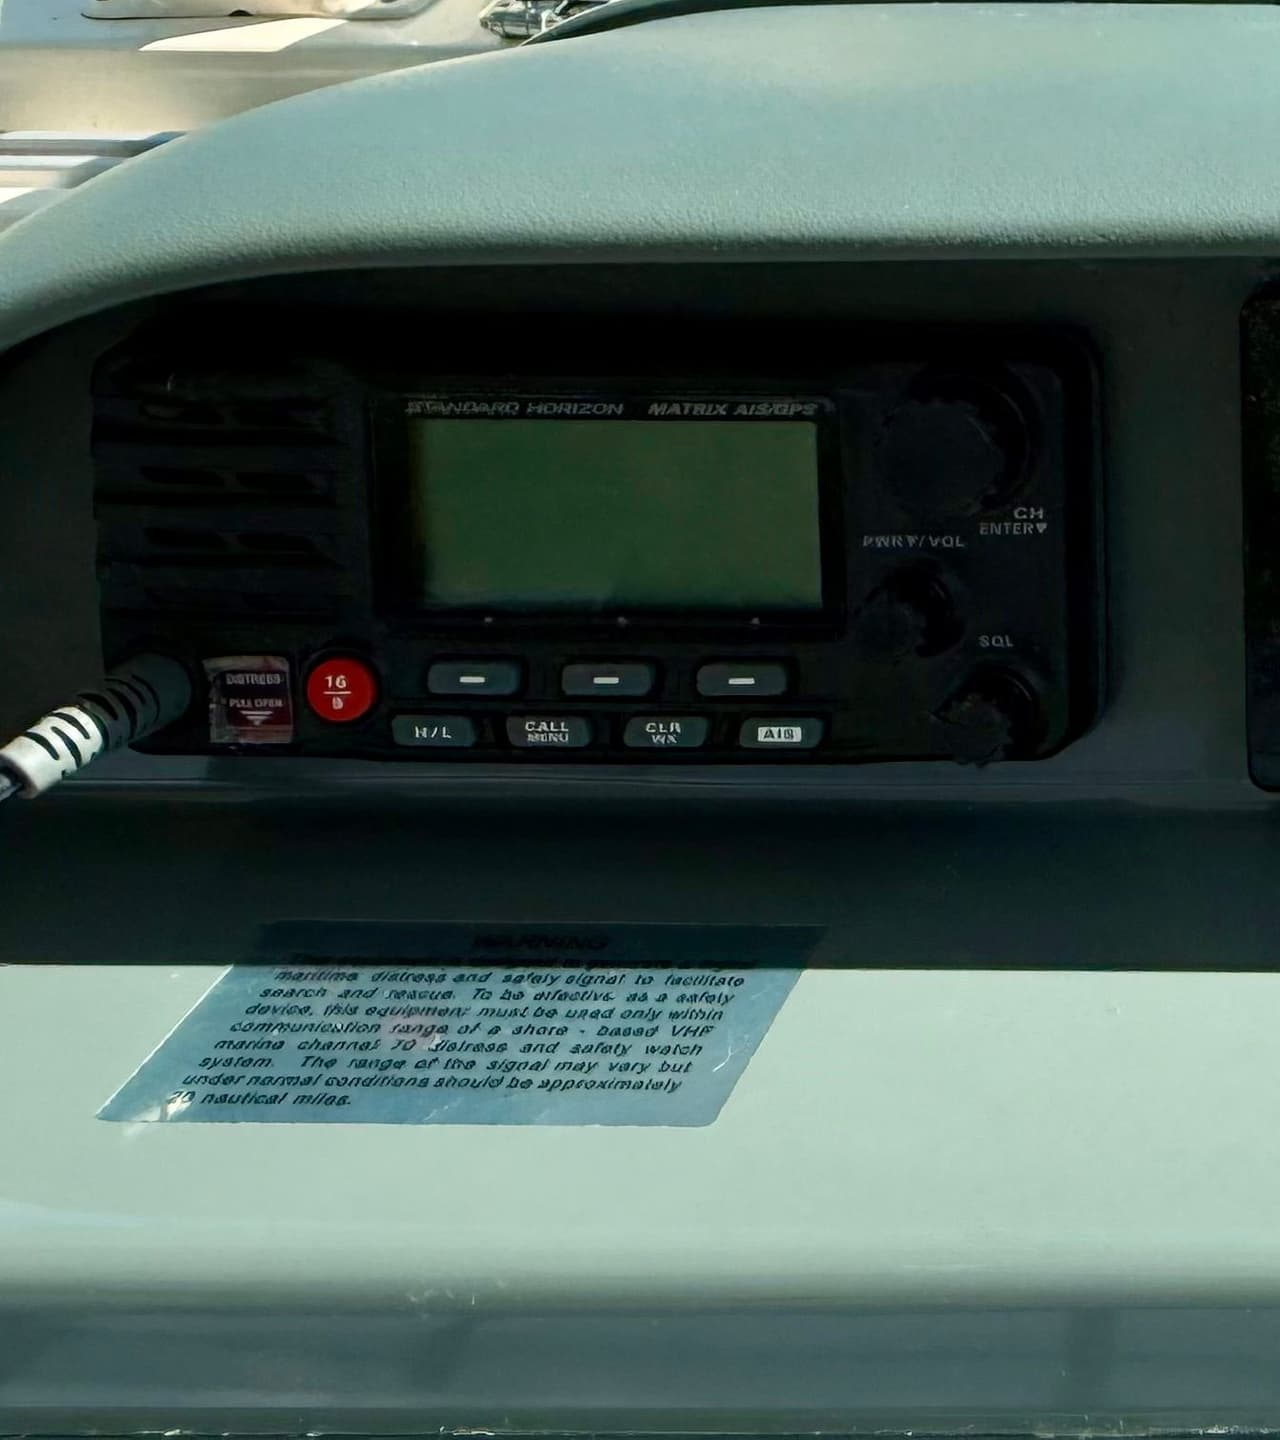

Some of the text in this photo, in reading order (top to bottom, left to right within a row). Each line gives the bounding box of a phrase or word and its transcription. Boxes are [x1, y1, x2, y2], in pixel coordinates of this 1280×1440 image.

[526, 401, 625, 417] HORIZON
[648, 402, 727, 416] MATRIX
[1013, 506, 1045, 520] CH
[979, 521, 1035, 536] ENTER
[978, 634, 1016, 649] SQL
[324, 674, 348, 689] 16
[525, 721, 569, 732] CALL
[274, 971, 358, 982] maritime
[371, 971, 447, 983] distress
[453, 971, 493, 982] and
[502, 972, 561, 987] safety
[565, 973, 626, 988] signal
[635, 974, 654, 986] to
[259, 987, 327, 998] search
[338, 987, 378, 999] and
[473, 988, 493, 1000] To
[500, 990, 525, 1001] be
[625, 993, 648, 1002] as
[656, 993, 668, 1003] a
[676, 992, 735, 1005] safety
[322, 1003, 359, 1017] this
[365, 1005, 468, 1020] equipment
[479, 1005, 528, 1018] must
[533, 1006, 558, 1019] be
[565, 1007, 613, 1020] used
[620, 1007, 661, 1022] only
[668, 1008, 724, 1021] within
[229, 1020, 381, 1034] communication
[389, 1023, 449, 1037] range
[457, 1022, 482, 1035] of
[487, 1025, 501, 1036] a
[597, 1024, 660, 1037] based
[671, 1024, 717, 1038] VHF
[214, 1038, 286, 1050] marine
[297, 1038, 382, 1052] channel
[519, 1041, 560, 1055] and
[569, 1042, 632, 1056] safety
[645, 1042, 703, 1056] watch
[300, 1055, 337, 1069] The
[347, 1058, 408, 1072] range
[414, 1056, 440, 1070] of
[442, 1058, 476, 1071] the
[486, 1058, 550, 1073] signal
[554, 1060, 598, 1074] may
[608, 1061, 650, 1075] vary
[658, 1060, 693, 1074] but
[182, 1073, 683, 1094] under normal conditions should be approximately
[200, 1091, 288, 1105] nautical
